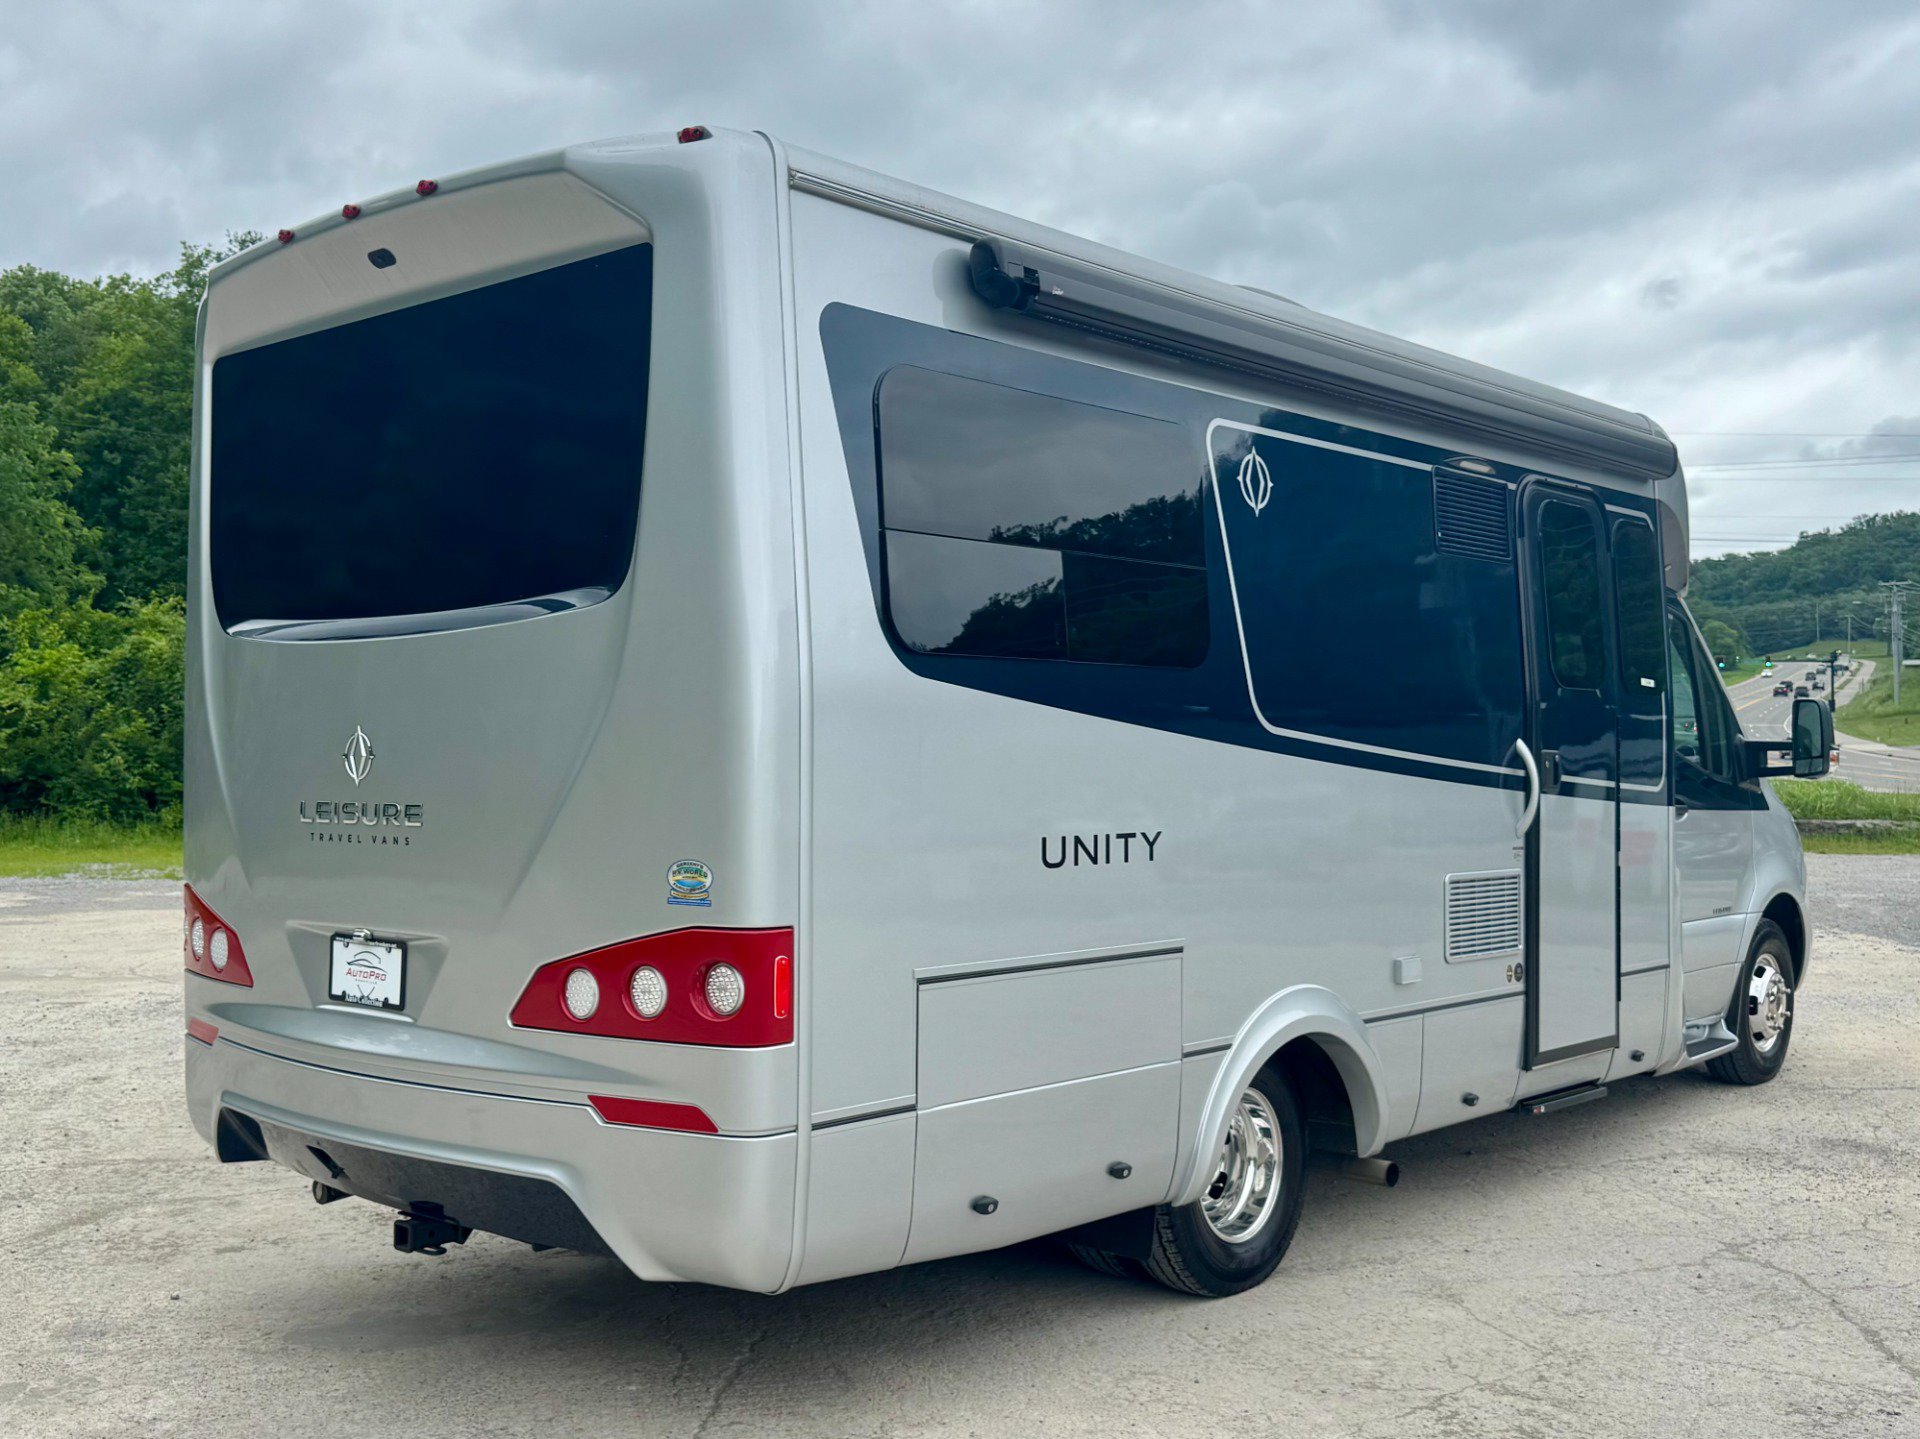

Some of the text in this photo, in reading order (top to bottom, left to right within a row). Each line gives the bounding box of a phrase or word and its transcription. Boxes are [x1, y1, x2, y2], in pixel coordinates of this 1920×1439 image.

[300, 800, 423, 827] LEISURE
[310, 832, 411, 846] TRAVEL VANS
[1041, 831, 1162, 869] UNITY
[683, 868, 709, 878] WORLD
